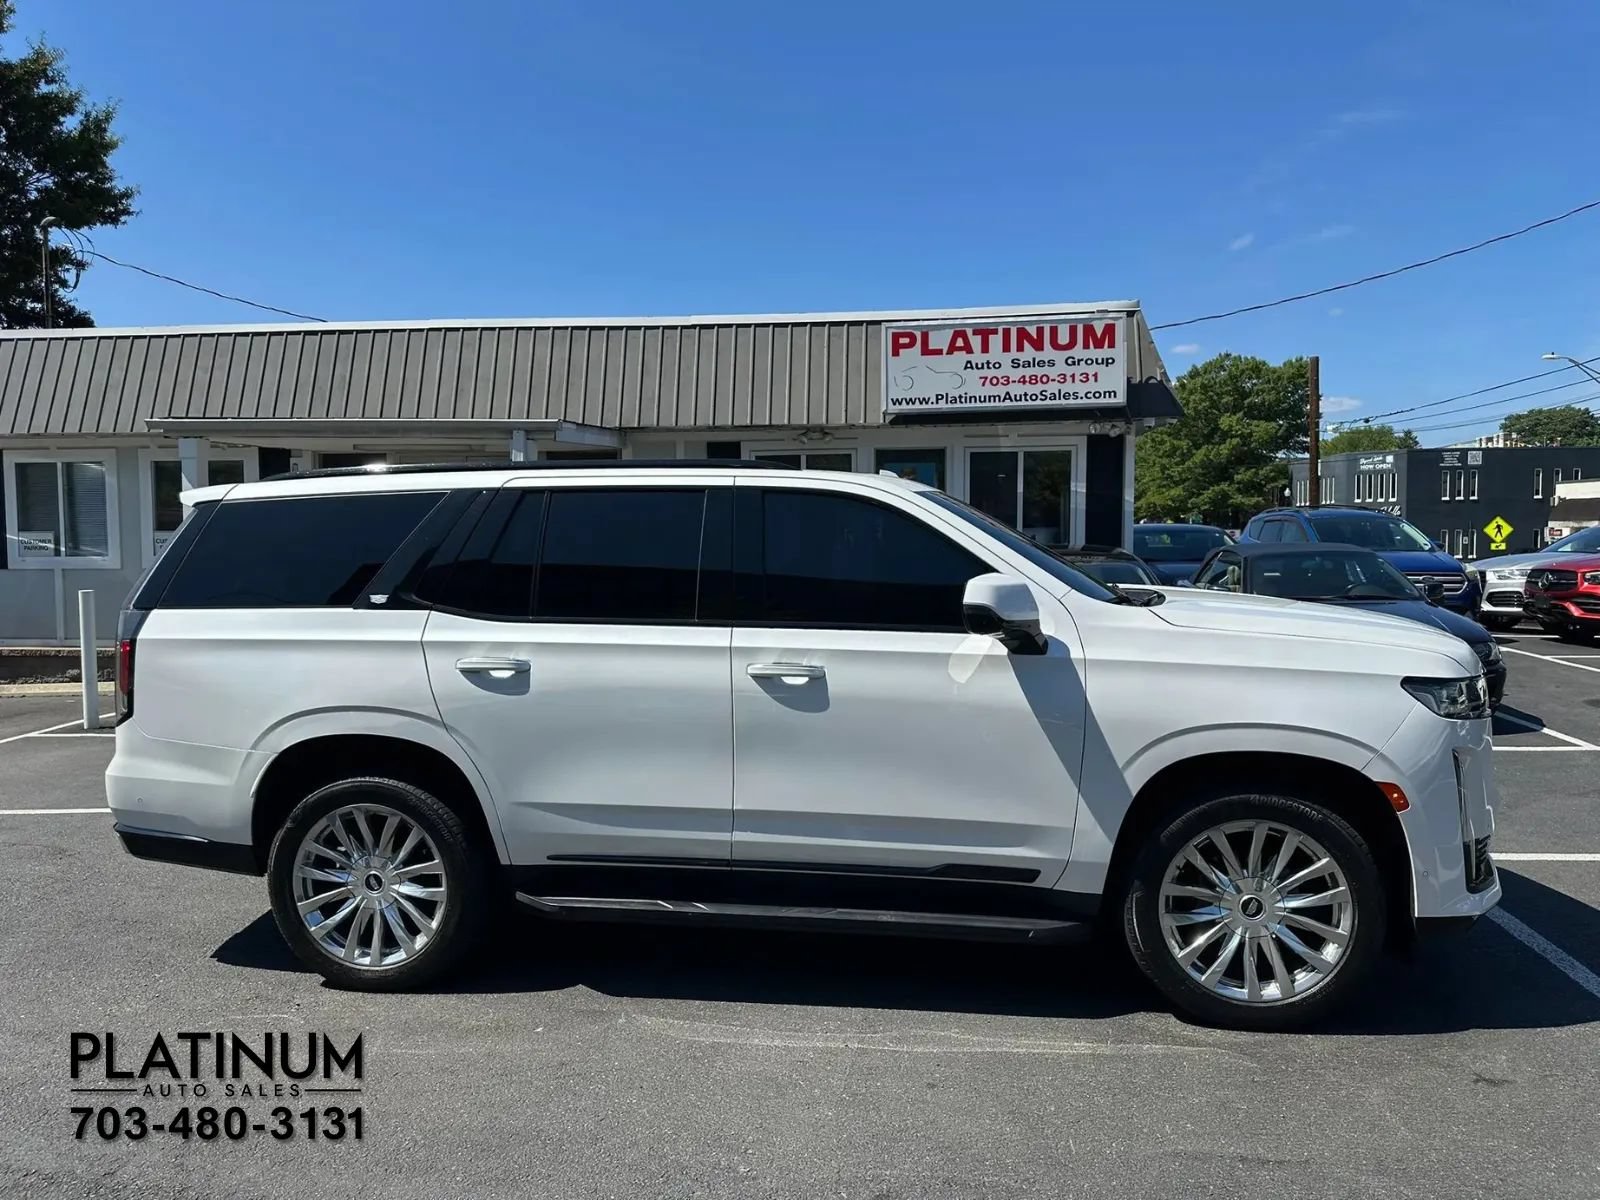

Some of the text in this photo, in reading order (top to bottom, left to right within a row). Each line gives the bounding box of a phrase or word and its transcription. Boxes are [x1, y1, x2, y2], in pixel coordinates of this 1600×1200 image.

[891, 322, 1116, 357] PLATINUM
[963, 355, 1116, 371] Auto Sales Group
[978, 372, 1099, 387] 703-480-3131
[890, 389, 1117, 406] www.PlatinumAutoSales.com
